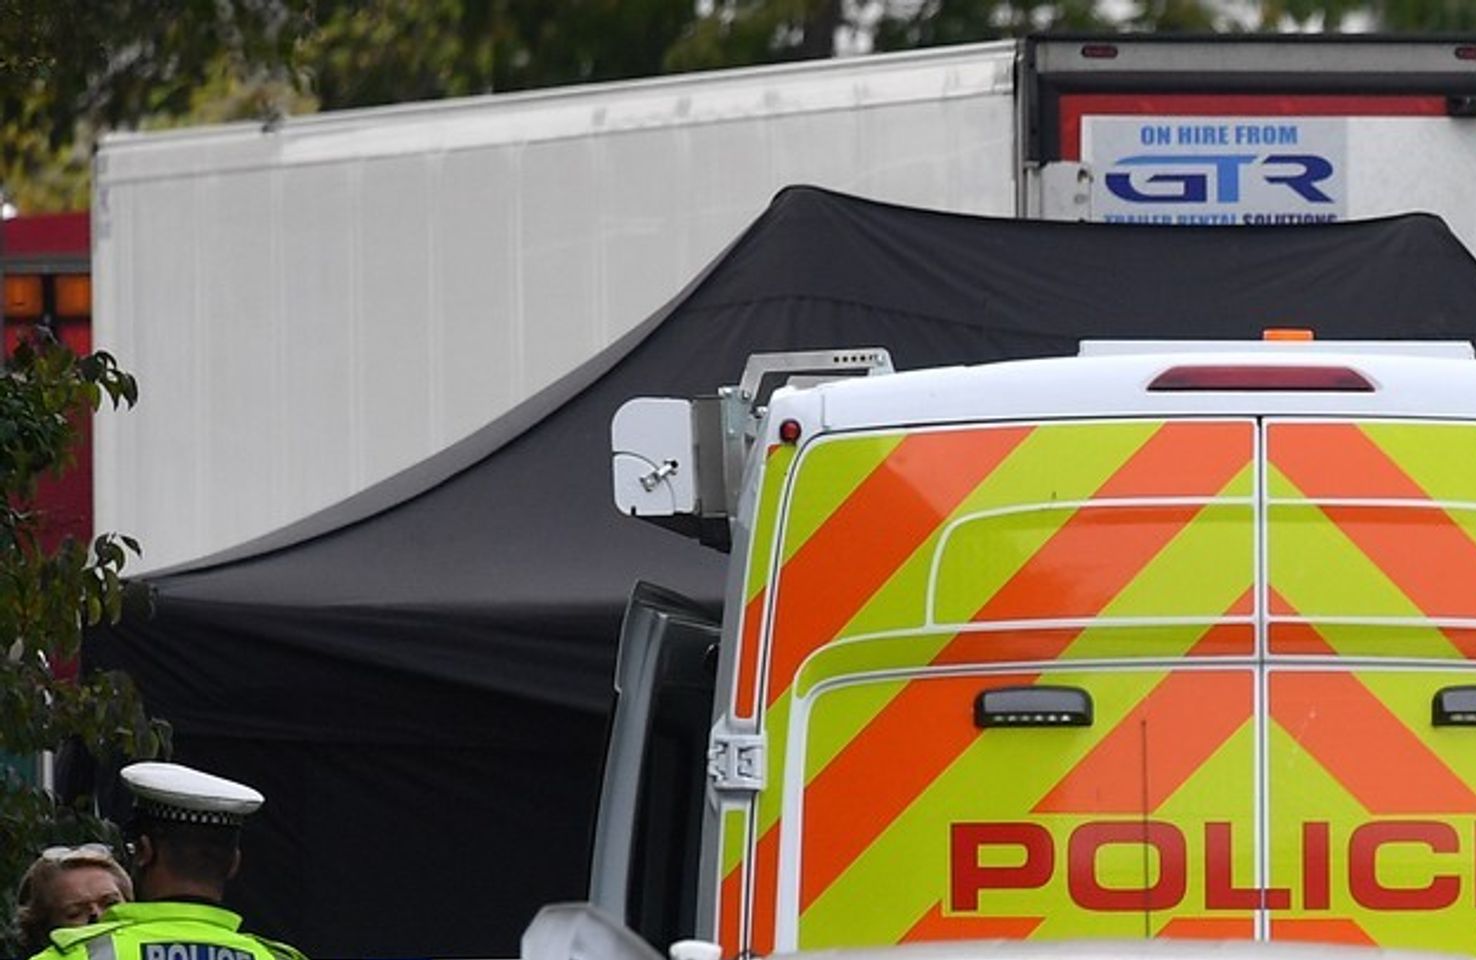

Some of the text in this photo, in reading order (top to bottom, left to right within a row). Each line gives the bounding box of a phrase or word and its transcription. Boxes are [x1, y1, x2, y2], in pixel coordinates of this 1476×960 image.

[1140, 125, 1298, 145] ON HIRE FROM
[1105, 154, 1335, 204] GTR
